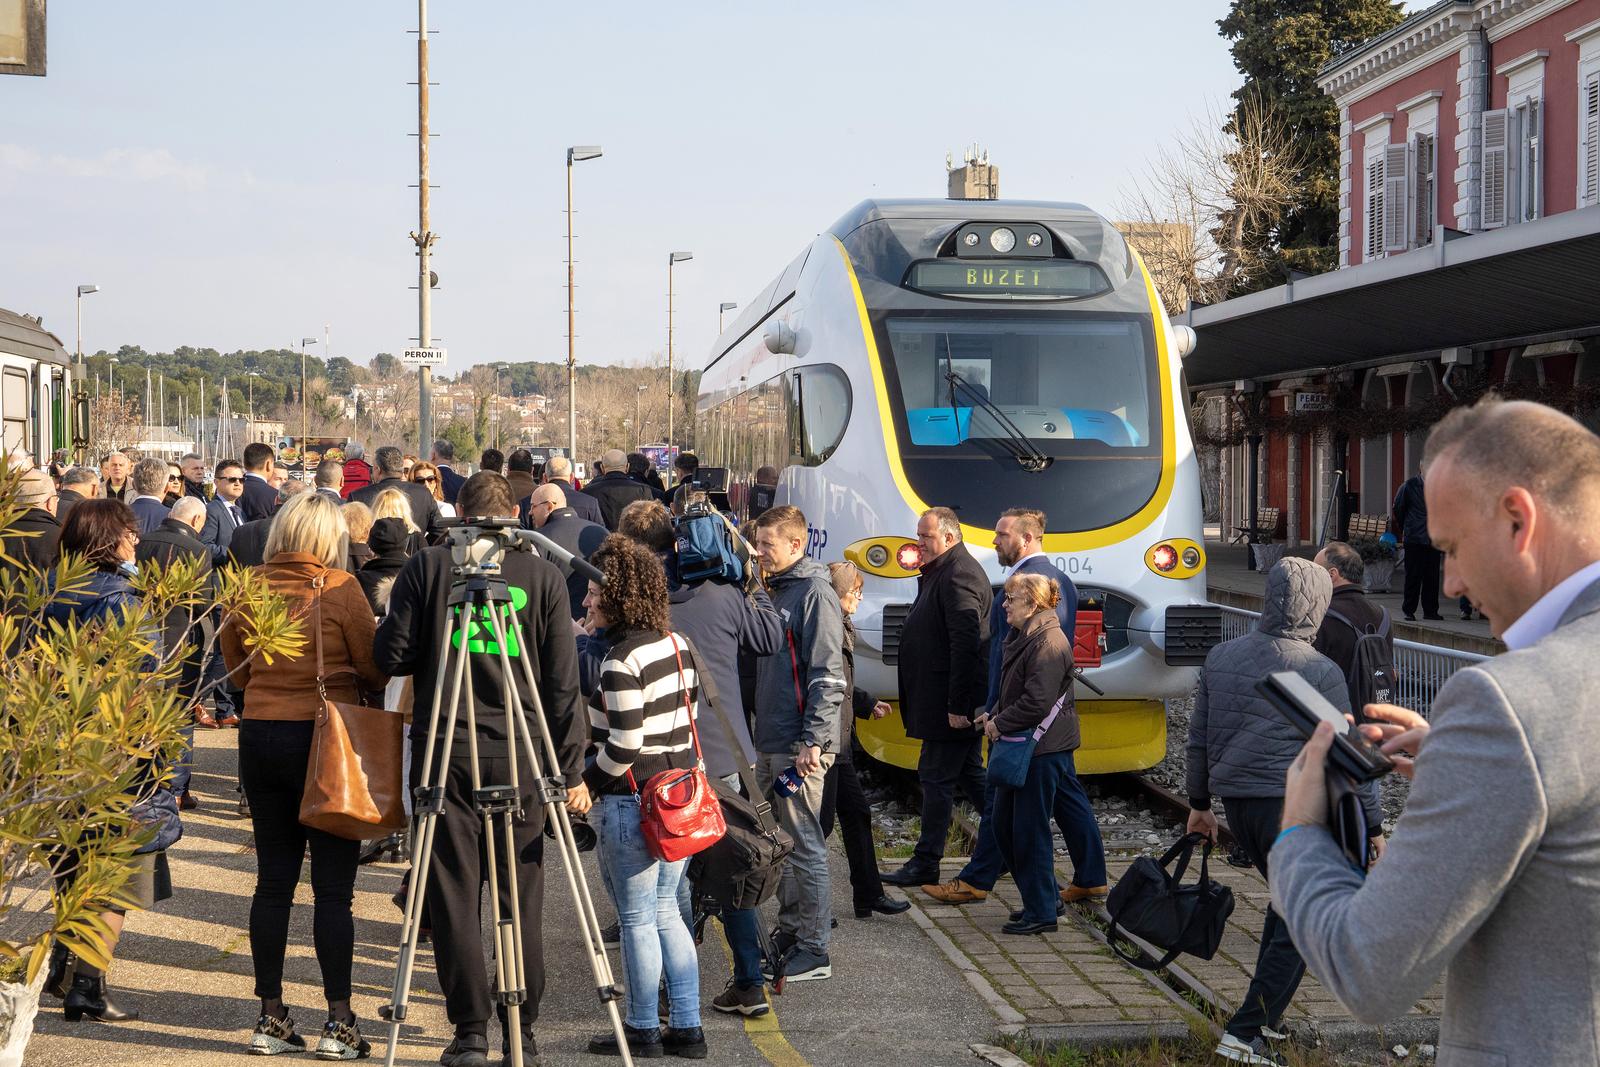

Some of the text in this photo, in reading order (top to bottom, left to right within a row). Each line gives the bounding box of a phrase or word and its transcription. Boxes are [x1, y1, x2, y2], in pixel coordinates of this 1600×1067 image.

[967, 268, 1041, 287] BUZET
[404, 350, 434, 359] PERON
[804, 522, 828, 560] ŽPP
[1055, 556, 1093, 575] 004
